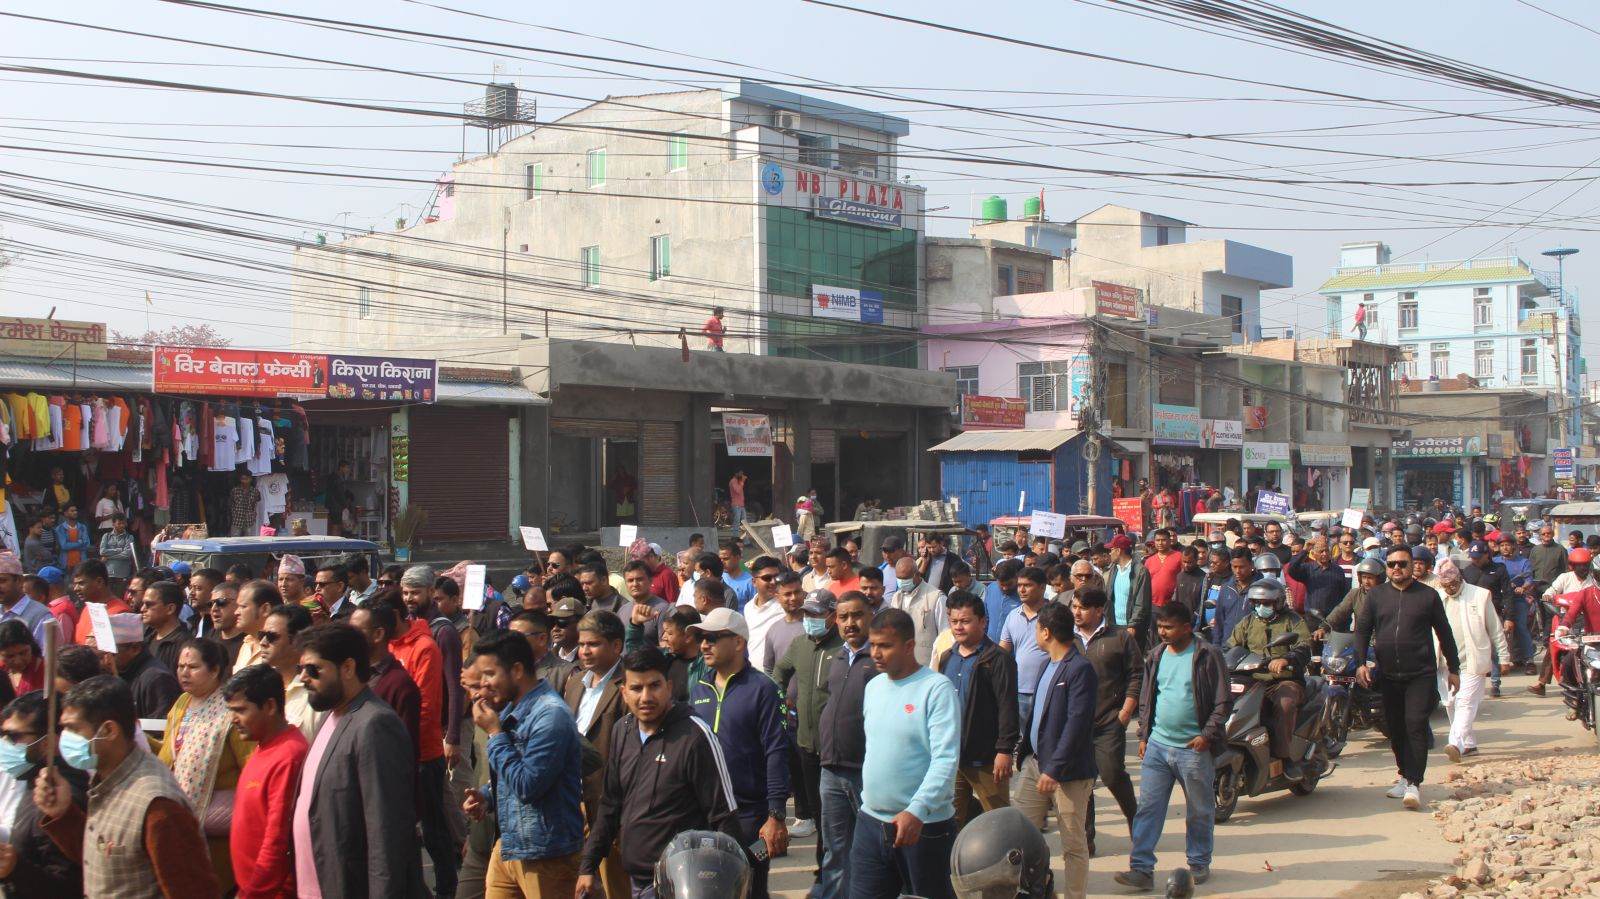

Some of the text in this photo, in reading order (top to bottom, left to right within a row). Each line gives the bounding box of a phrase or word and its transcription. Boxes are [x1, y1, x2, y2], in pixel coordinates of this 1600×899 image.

[797, 171, 903, 209] NB PLAZA
[174, 353, 311, 378] विर बेताल फेन्सी
[332, 359, 432, 383] किरण किराना
